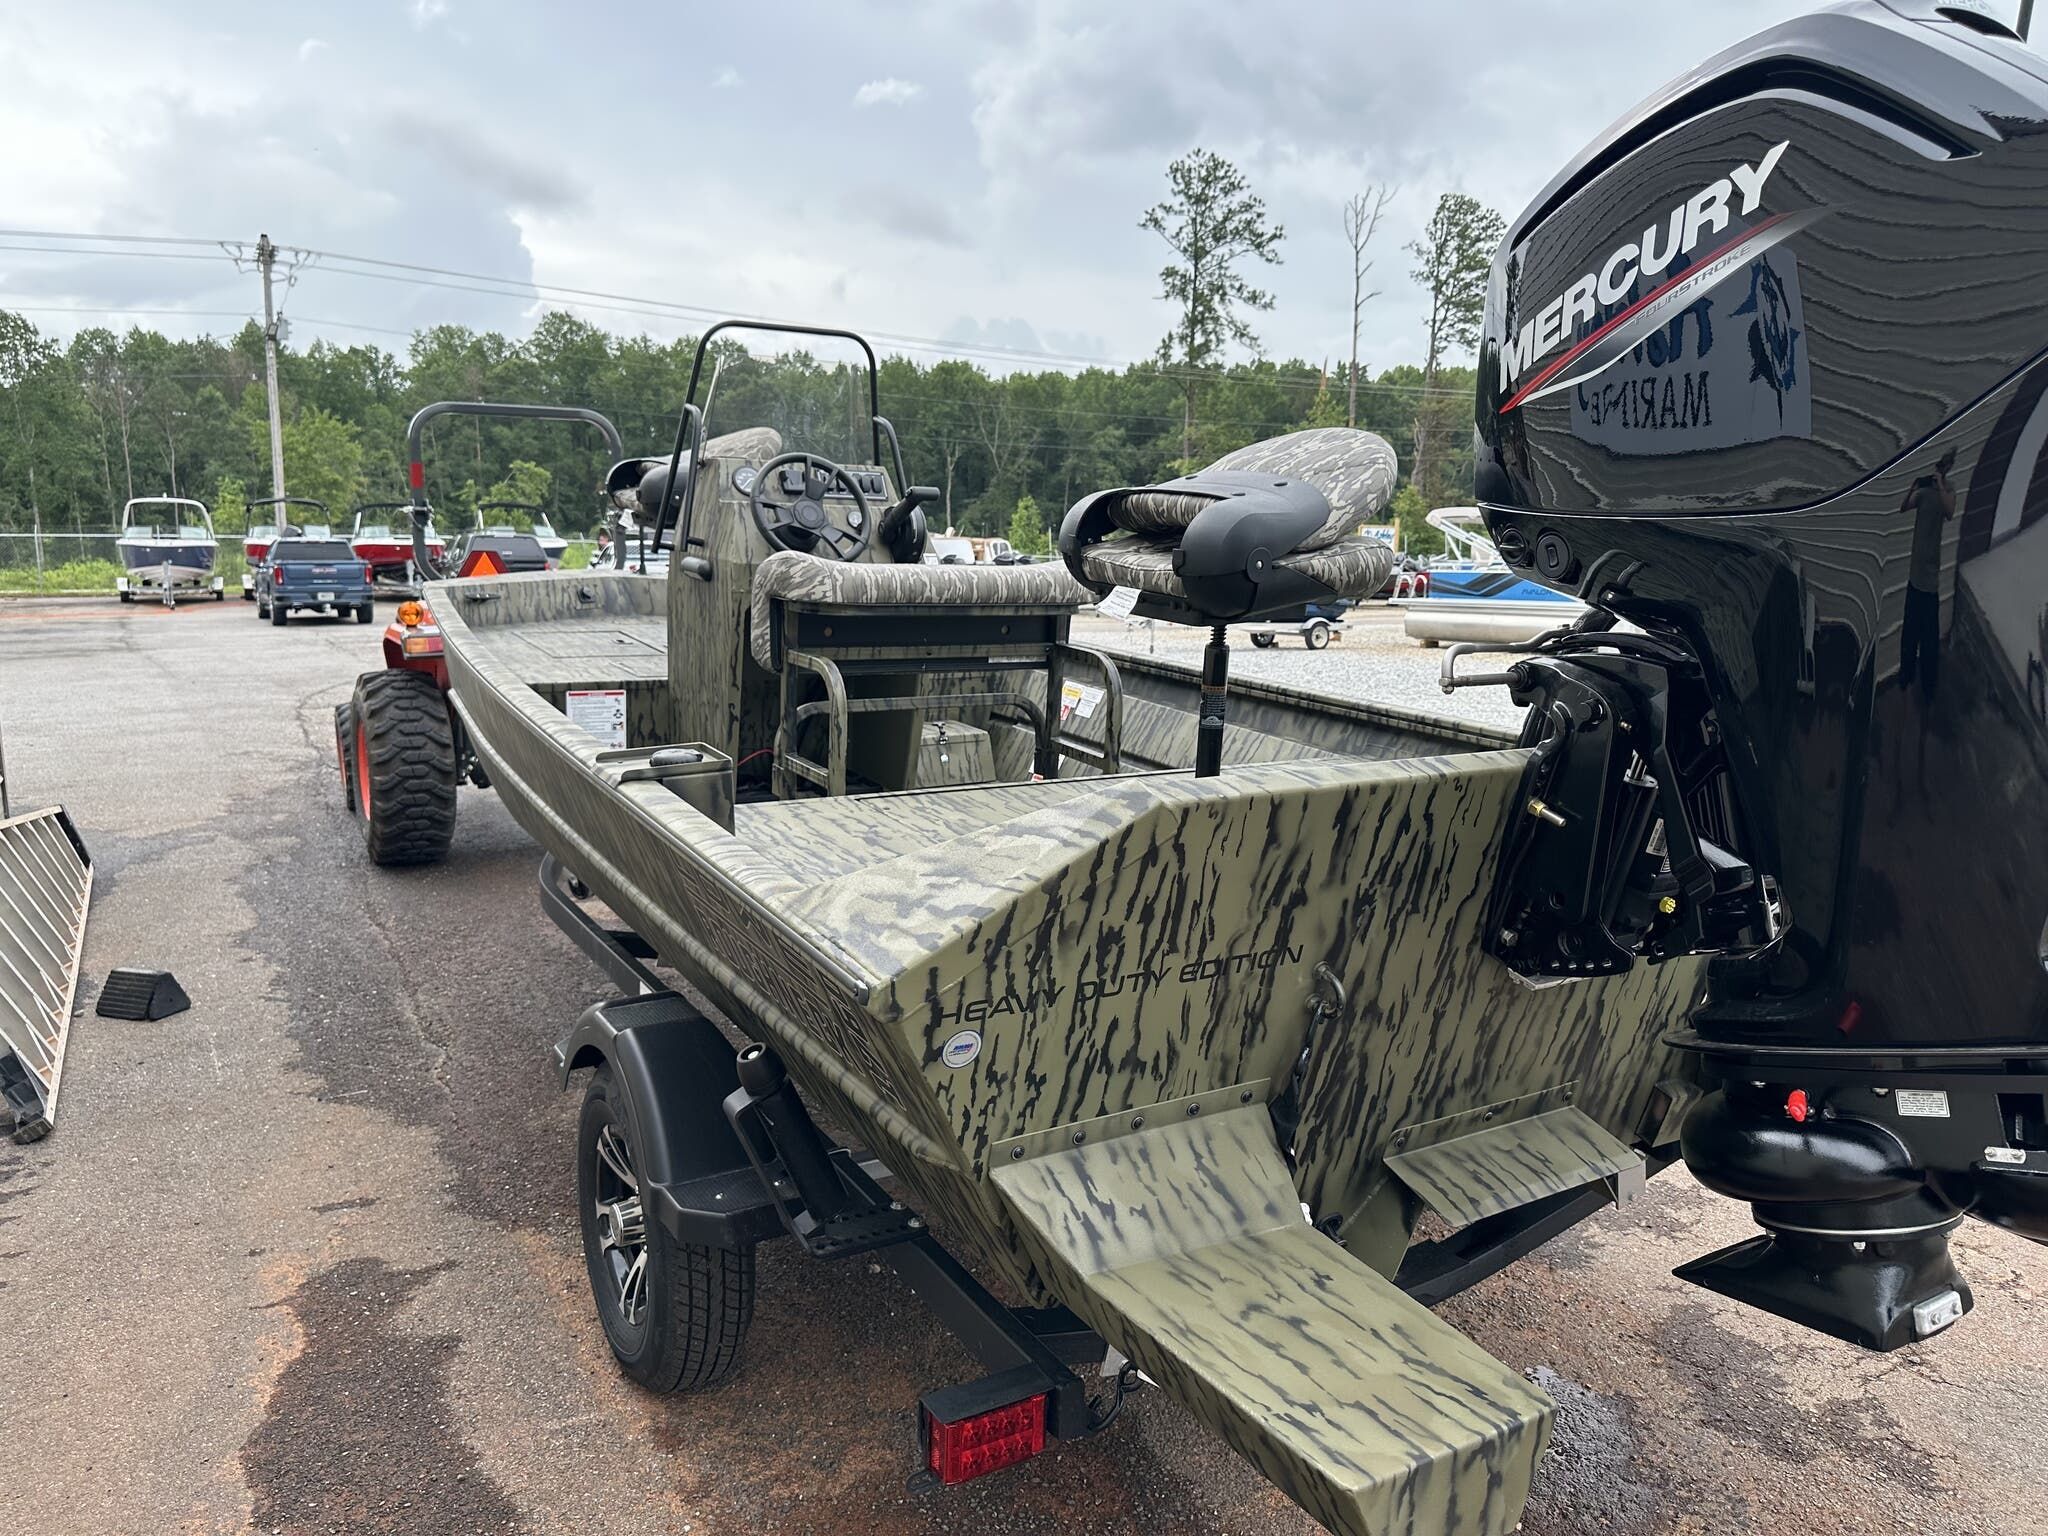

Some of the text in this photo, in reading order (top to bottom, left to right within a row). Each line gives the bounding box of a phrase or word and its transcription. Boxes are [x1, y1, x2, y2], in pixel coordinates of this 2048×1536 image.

[1500, 140, 1790, 394] MERCURY
[1634, 242, 1752, 326] FOURSTROKE
[937, 944, 1304, 1026] HEAVY DUTY EDITION
